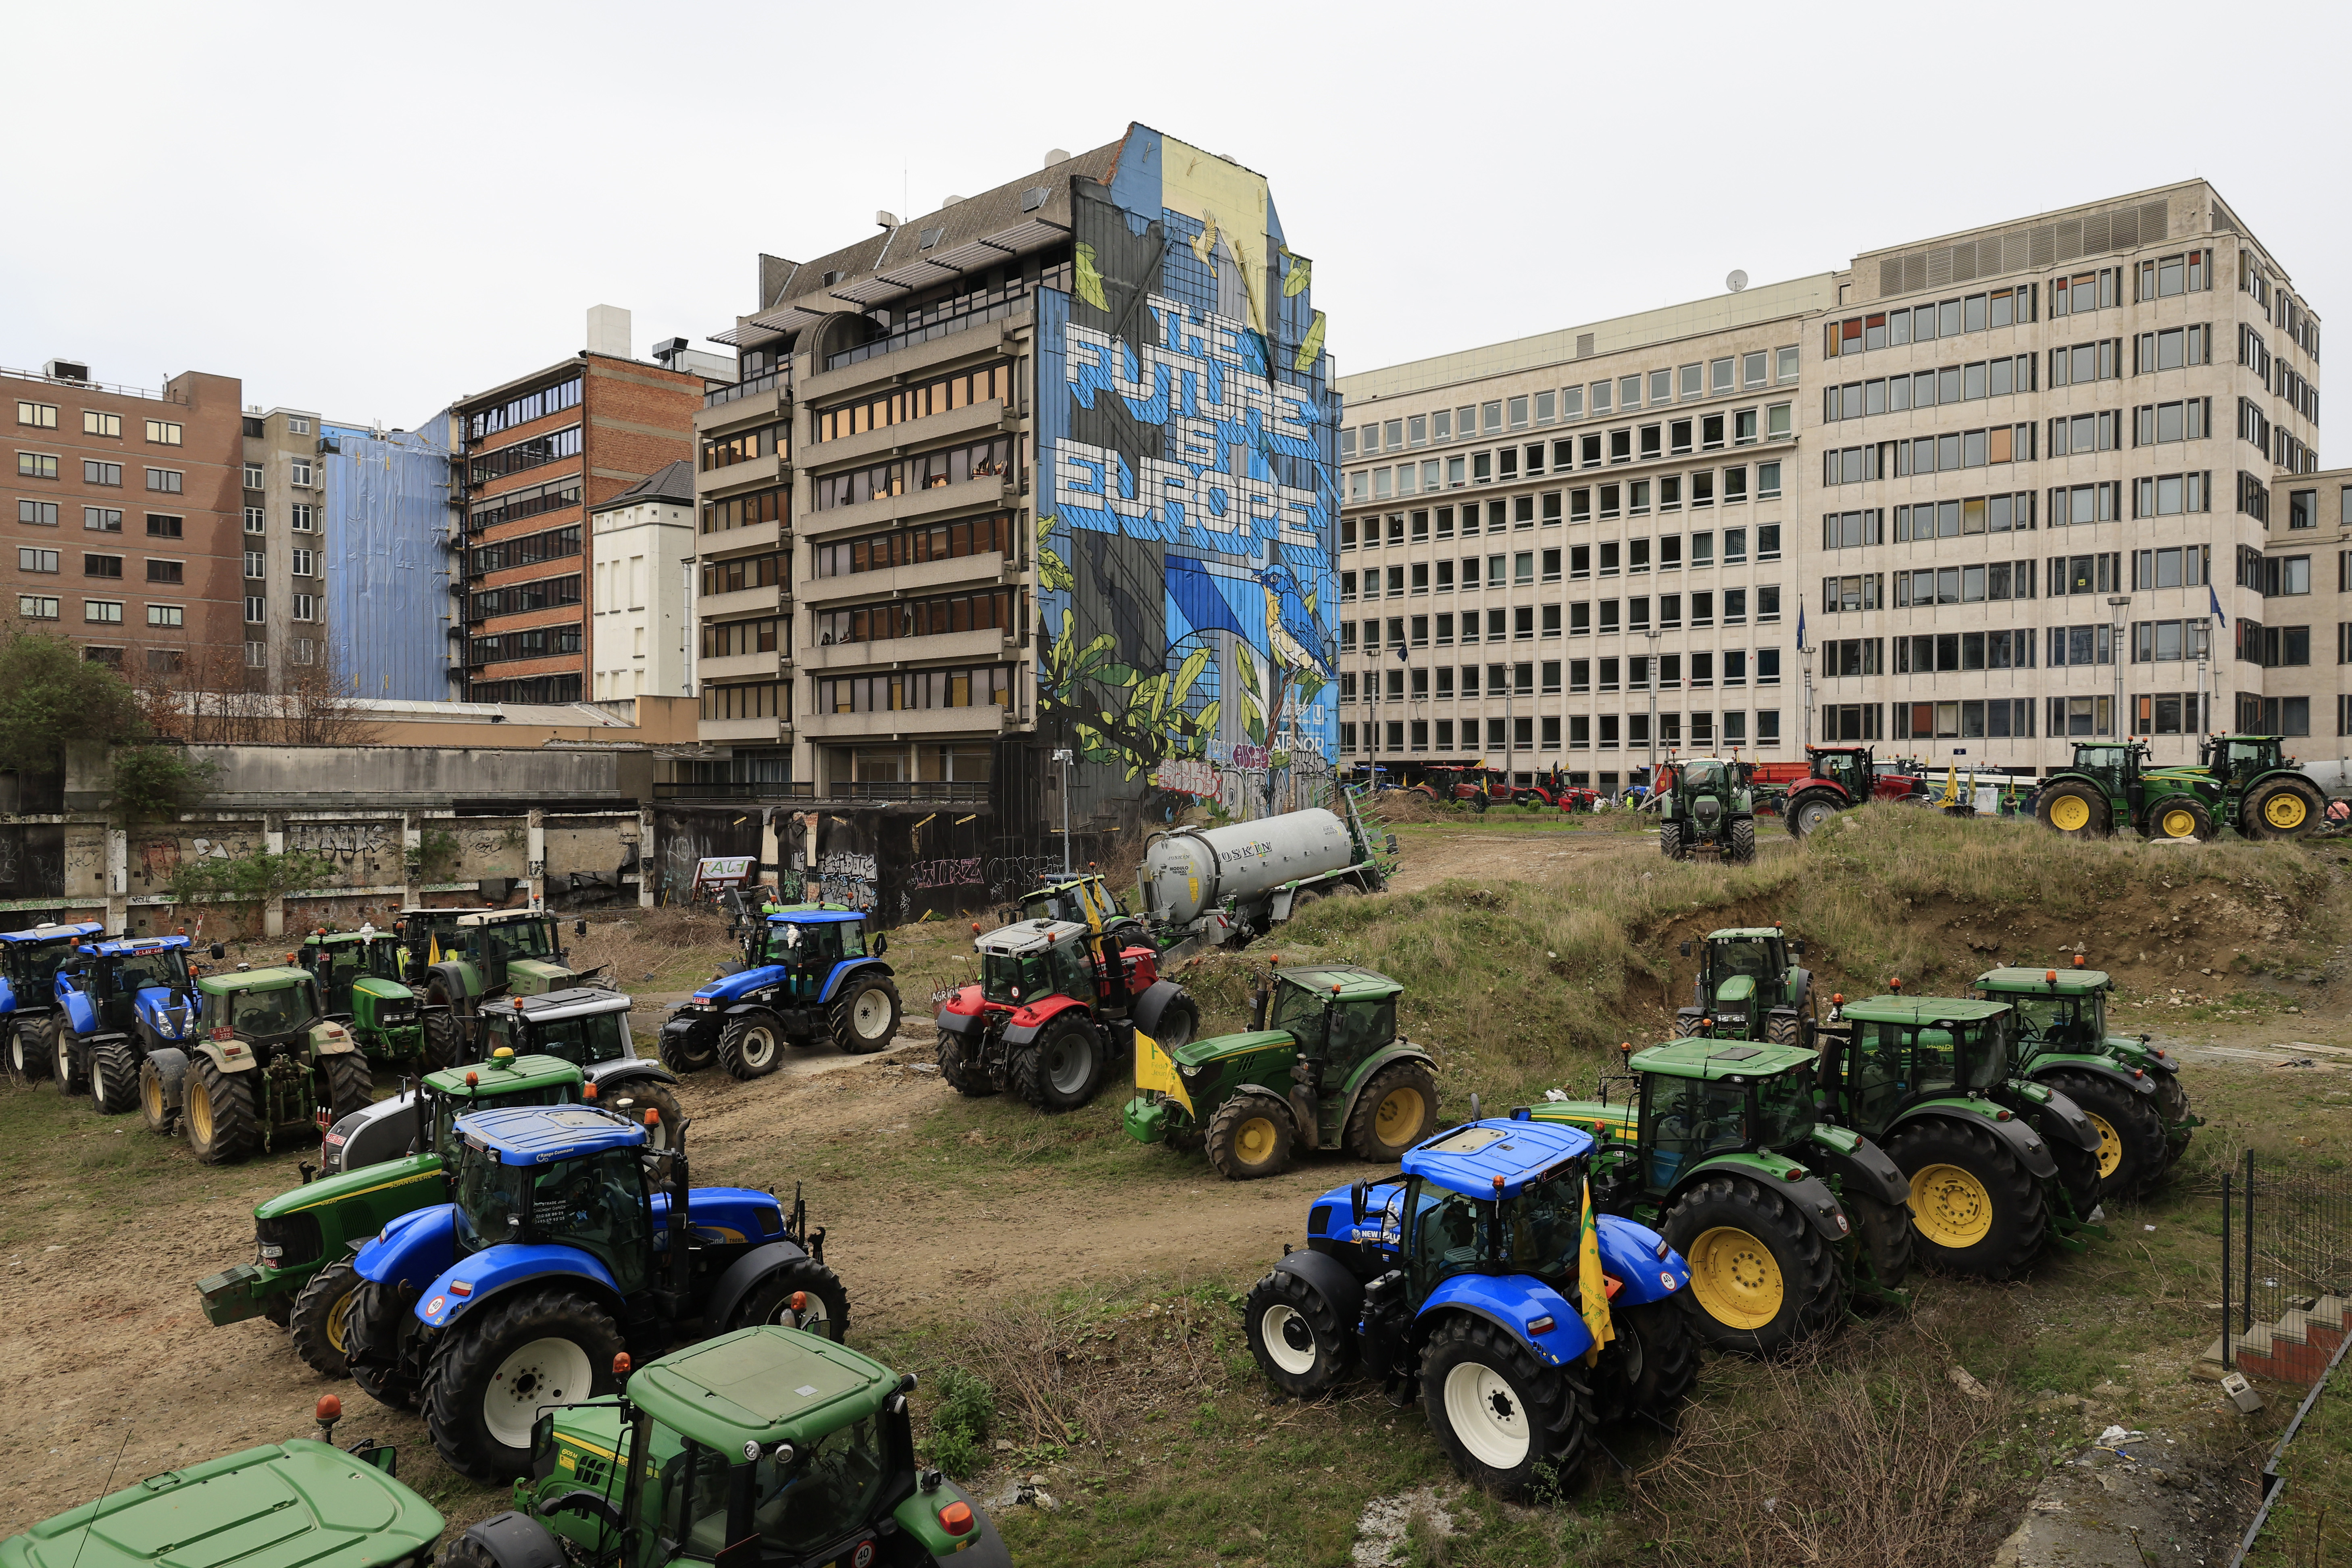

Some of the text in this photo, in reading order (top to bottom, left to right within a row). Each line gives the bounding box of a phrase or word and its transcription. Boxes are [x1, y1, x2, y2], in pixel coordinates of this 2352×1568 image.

[1147, 293, 1244, 367] THE
[1065, 321, 1308, 441] FUTURE
[1176, 415, 1217, 467] IS
[1055, 437, 1317, 549] EUROPE
[1271, 731, 1325, 757] ATENOR
[554, 1147, 574, 1155] Command
[389, 1174, 433, 1189] JOHN DEERE
[1663, 1274, 1671, 1283] 40
[432, 1301, 441, 1309] 40
[561, 1448, 578, 1459] 6105M
[857, 1547, 869, 1560] 40
